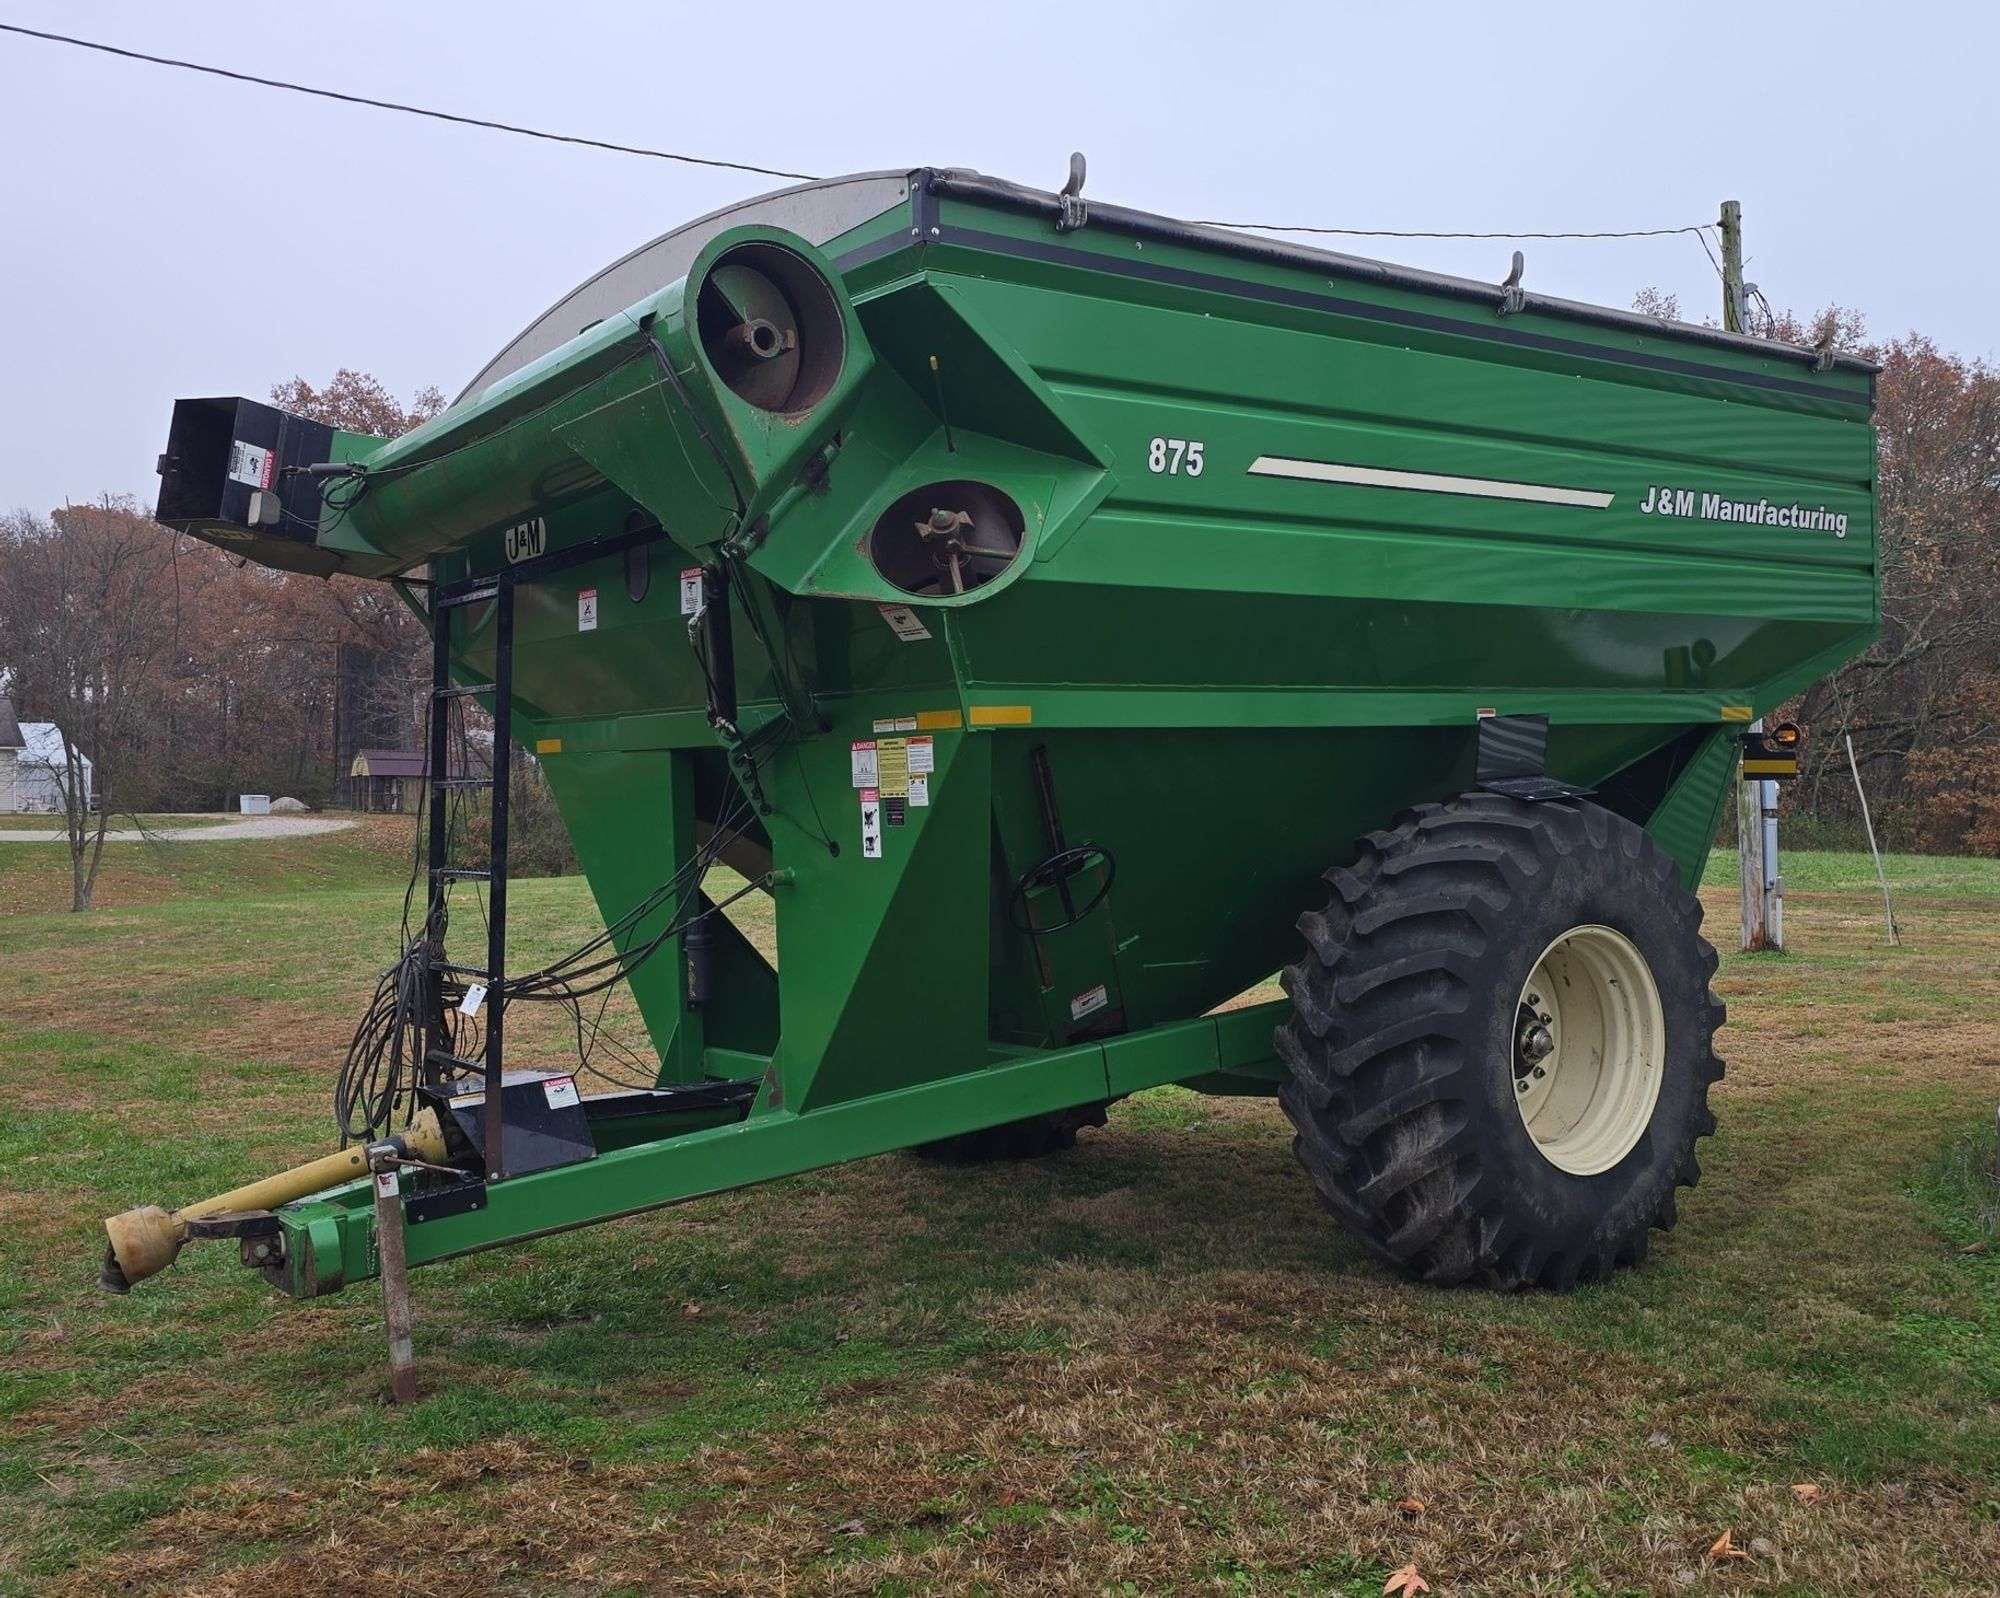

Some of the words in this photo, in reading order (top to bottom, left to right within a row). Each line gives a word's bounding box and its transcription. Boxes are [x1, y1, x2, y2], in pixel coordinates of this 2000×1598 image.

[1147, 437, 1204, 477] 875
[1640, 486, 1695, 518] J&M
[1700, 492, 1849, 538] Manufacturing
[508, 514, 542, 561] J&M
